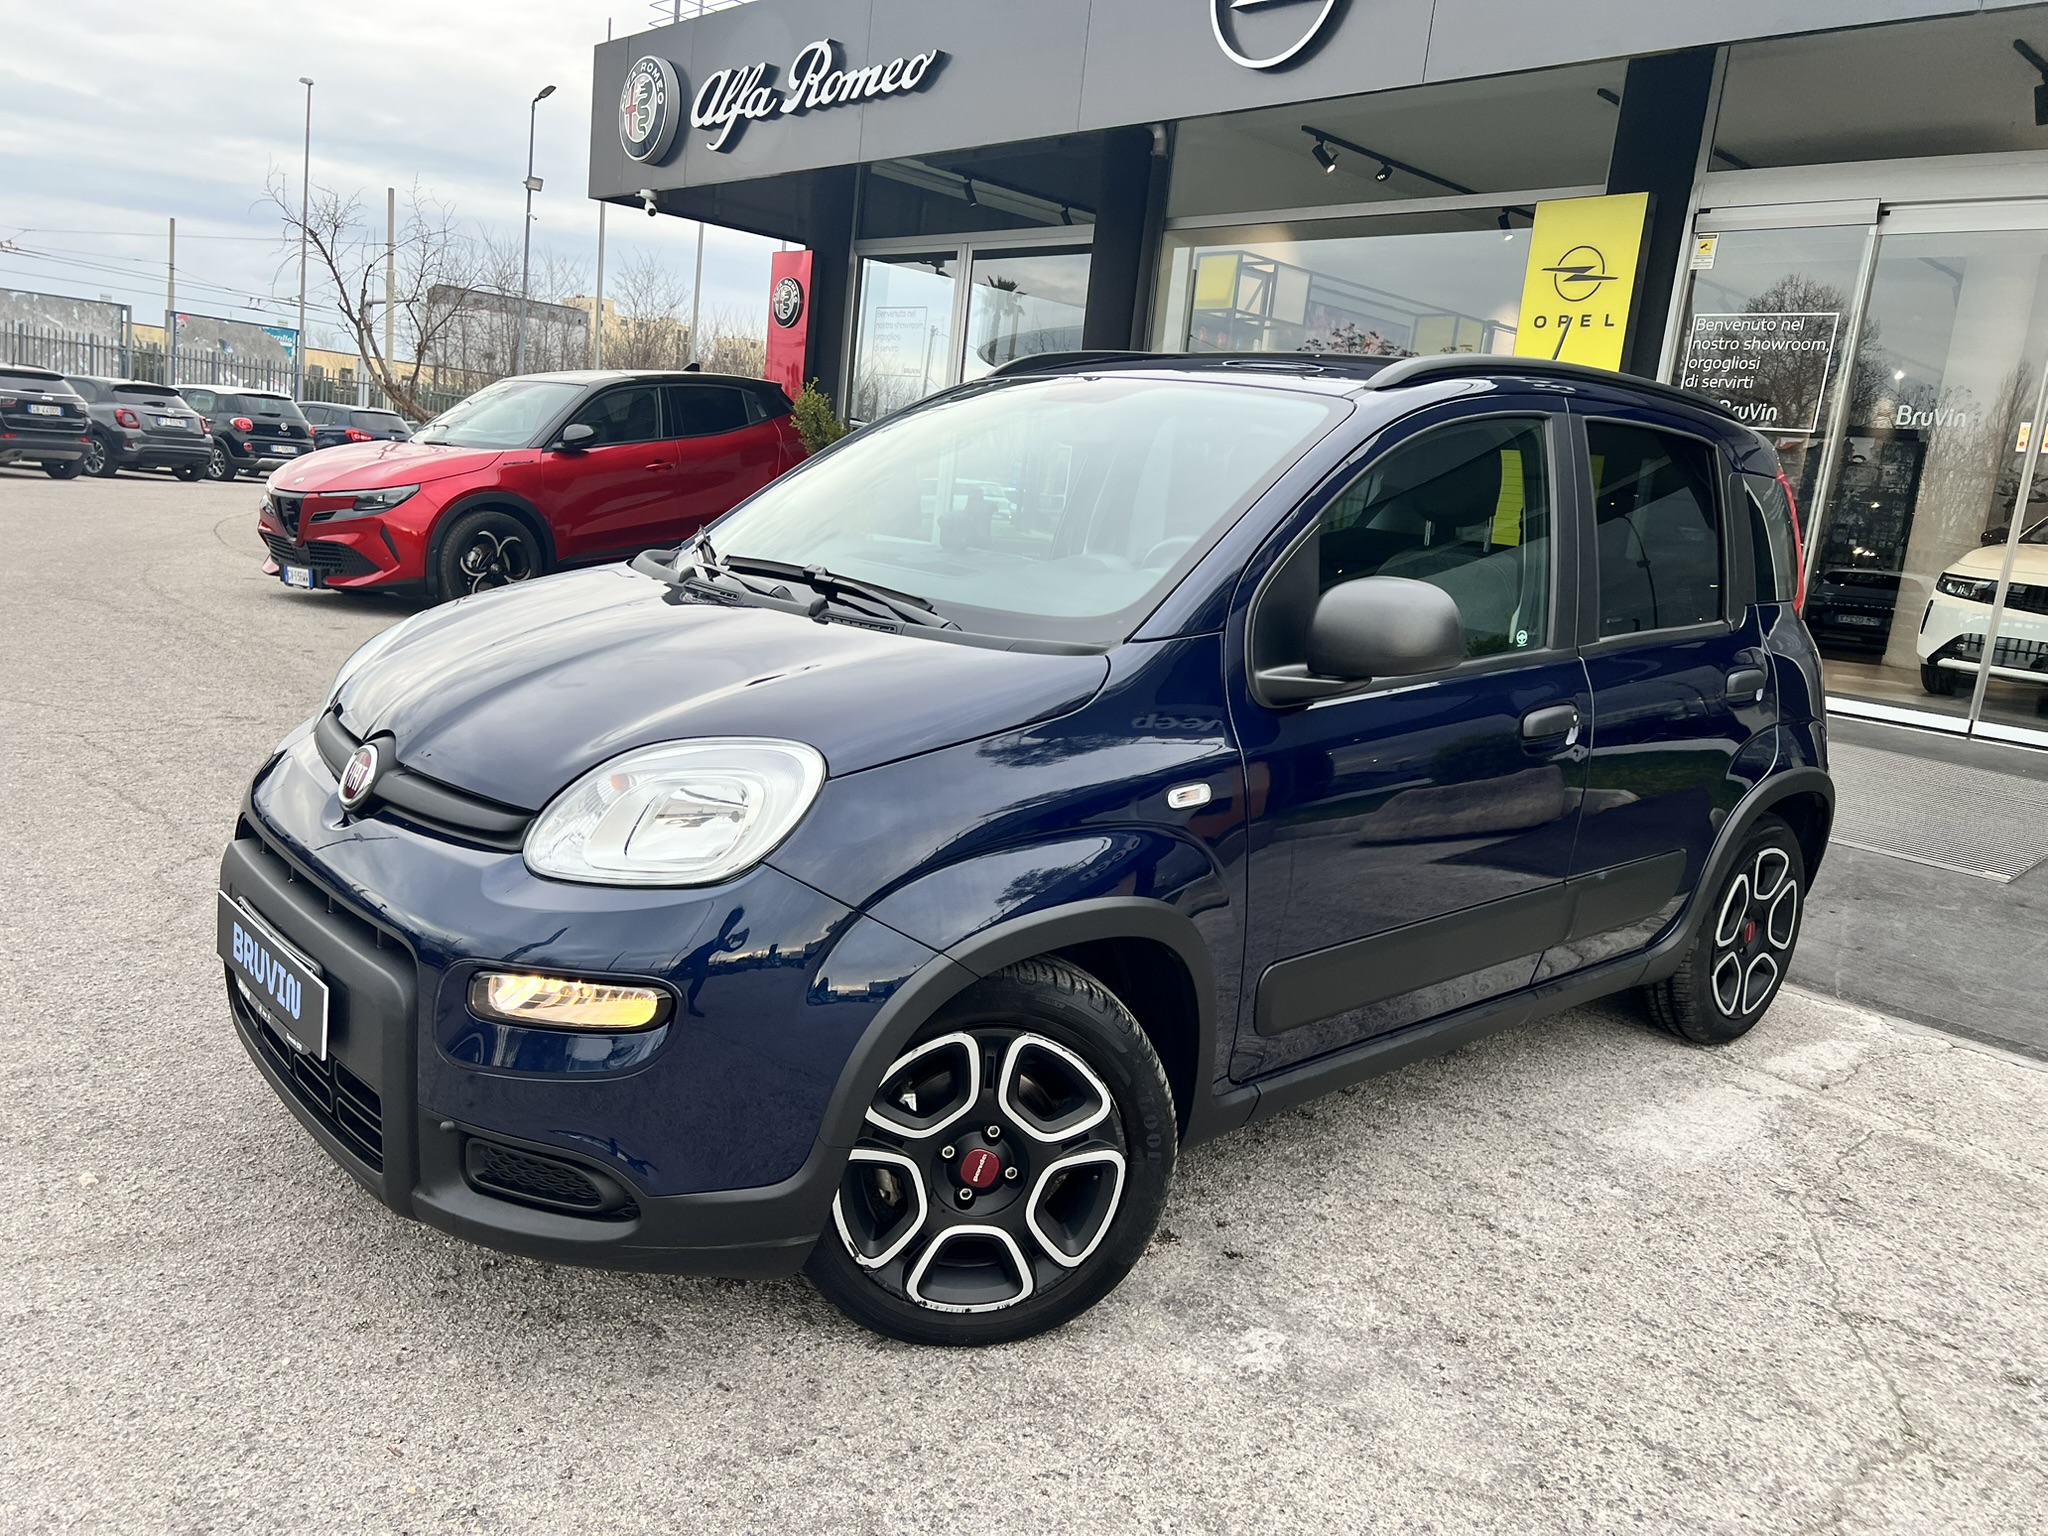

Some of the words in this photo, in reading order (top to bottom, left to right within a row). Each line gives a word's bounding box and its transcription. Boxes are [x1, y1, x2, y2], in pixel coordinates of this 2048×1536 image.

[640, 62, 665, 105] ROMEO
[690, 62, 777, 151] Alfa
[780, 38, 936, 113] Romeo
[1533, 313, 1615, 329] OPEL
[1696, 318, 1777, 331] Benvenuto
[1781, 316, 1805, 331] nel
[1692, 337, 1740, 350] nostro
[1743, 336, 1830, 353] showroom,
[1688, 355, 1761, 373] orgogliosi
[1685, 373, 1699, 388] di
[1701, 375, 1755, 389] servirti
[1895, 404, 1967, 428] BruVin
[345, 760, 369, 792] FIAT
[233, 921, 301, 1020] BRUVIN
